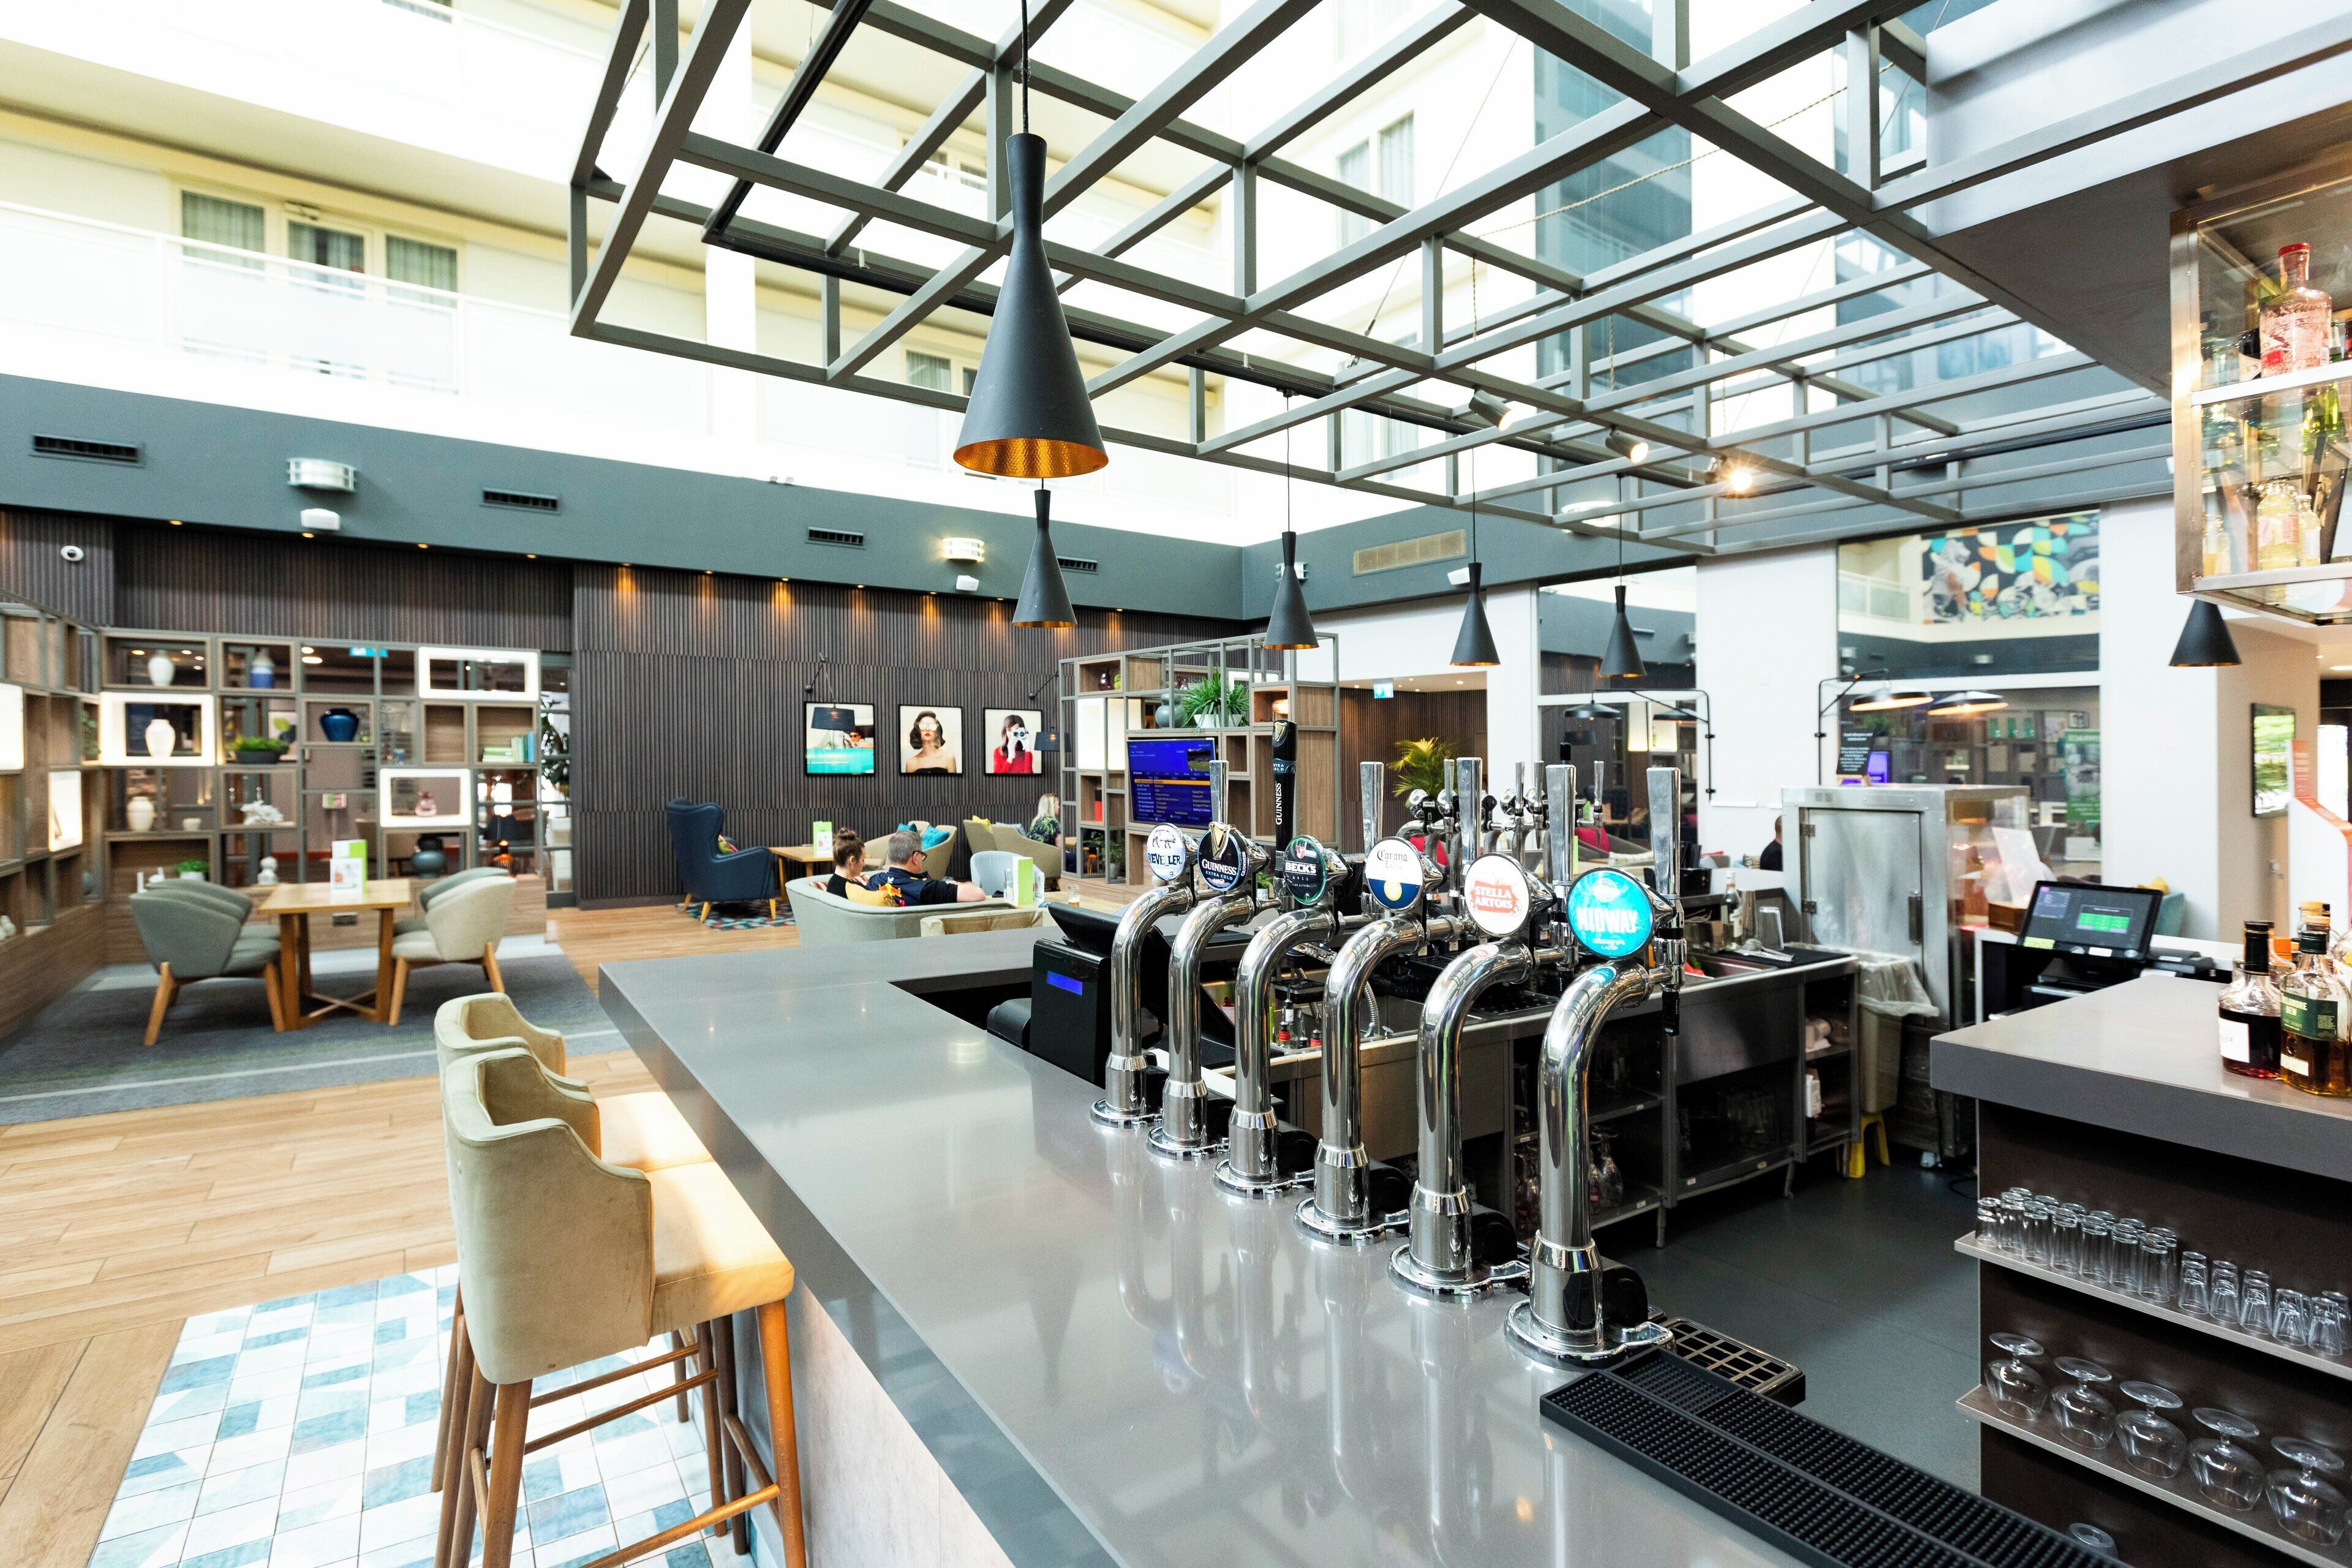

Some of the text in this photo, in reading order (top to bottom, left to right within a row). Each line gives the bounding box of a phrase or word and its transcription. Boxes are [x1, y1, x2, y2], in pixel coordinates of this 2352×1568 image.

[1377, 850, 1408, 862] Corona
[1202, 859, 1237, 876] GUINNESS
[1285, 861, 1317, 874] BECK'S
[1385, 861, 1402, 870] Extra
[1474, 886, 1512, 899] STELLA
[1474, 896, 1513, 909] ARTOIS
[1577, 907, 1638, 933] MIDWAY
